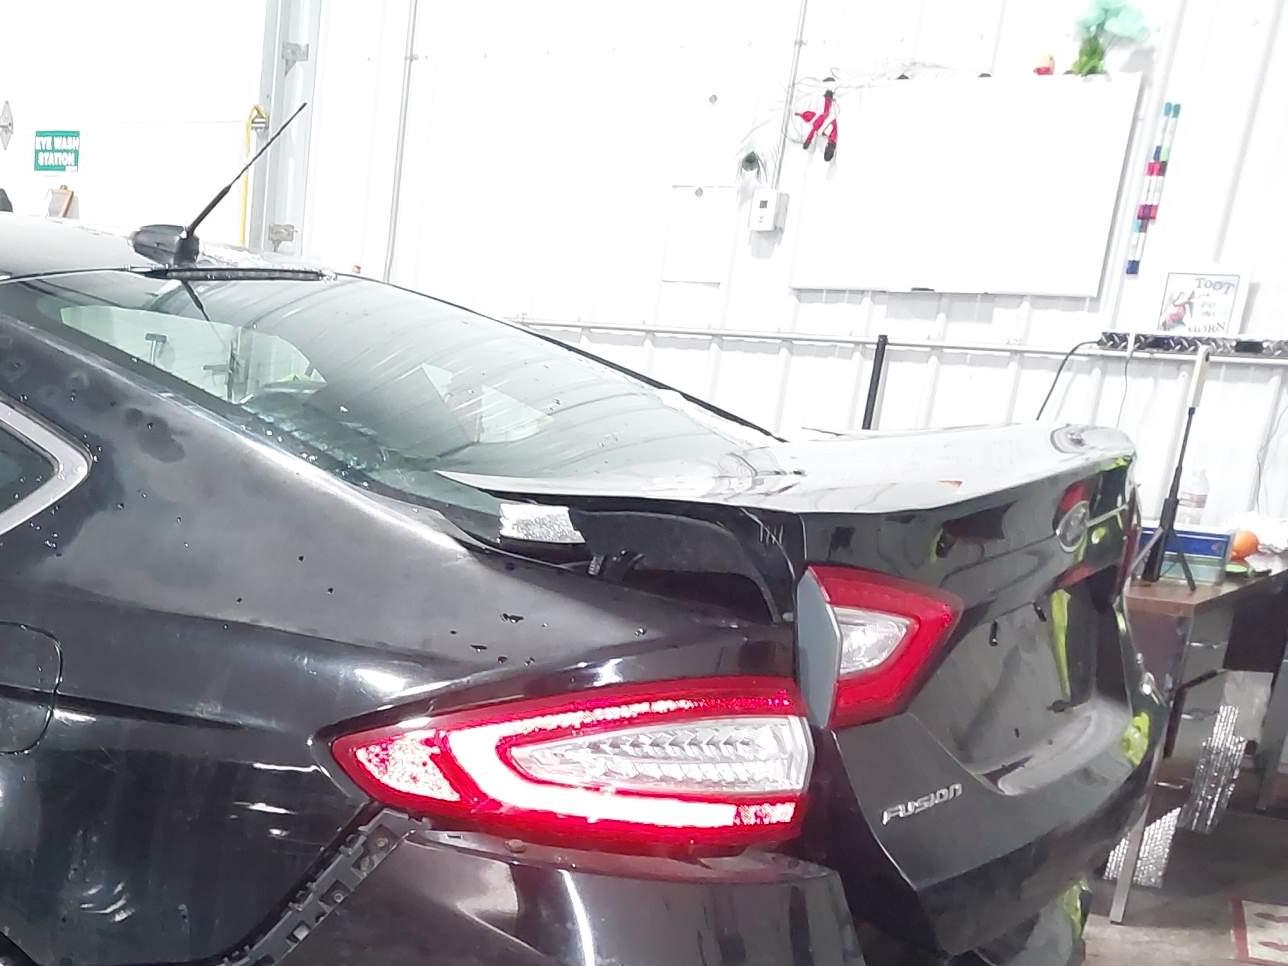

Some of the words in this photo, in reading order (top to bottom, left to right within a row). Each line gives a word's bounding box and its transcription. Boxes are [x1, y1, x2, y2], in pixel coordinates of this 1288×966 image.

[35, 136, 53, 150] EYE
[54, 136, 80, 150] WASH
[38, 151, 75, 166] STATION
[1195, 277, 1235, 295] TOOT
[882, 783, 963, 825] FUSION
